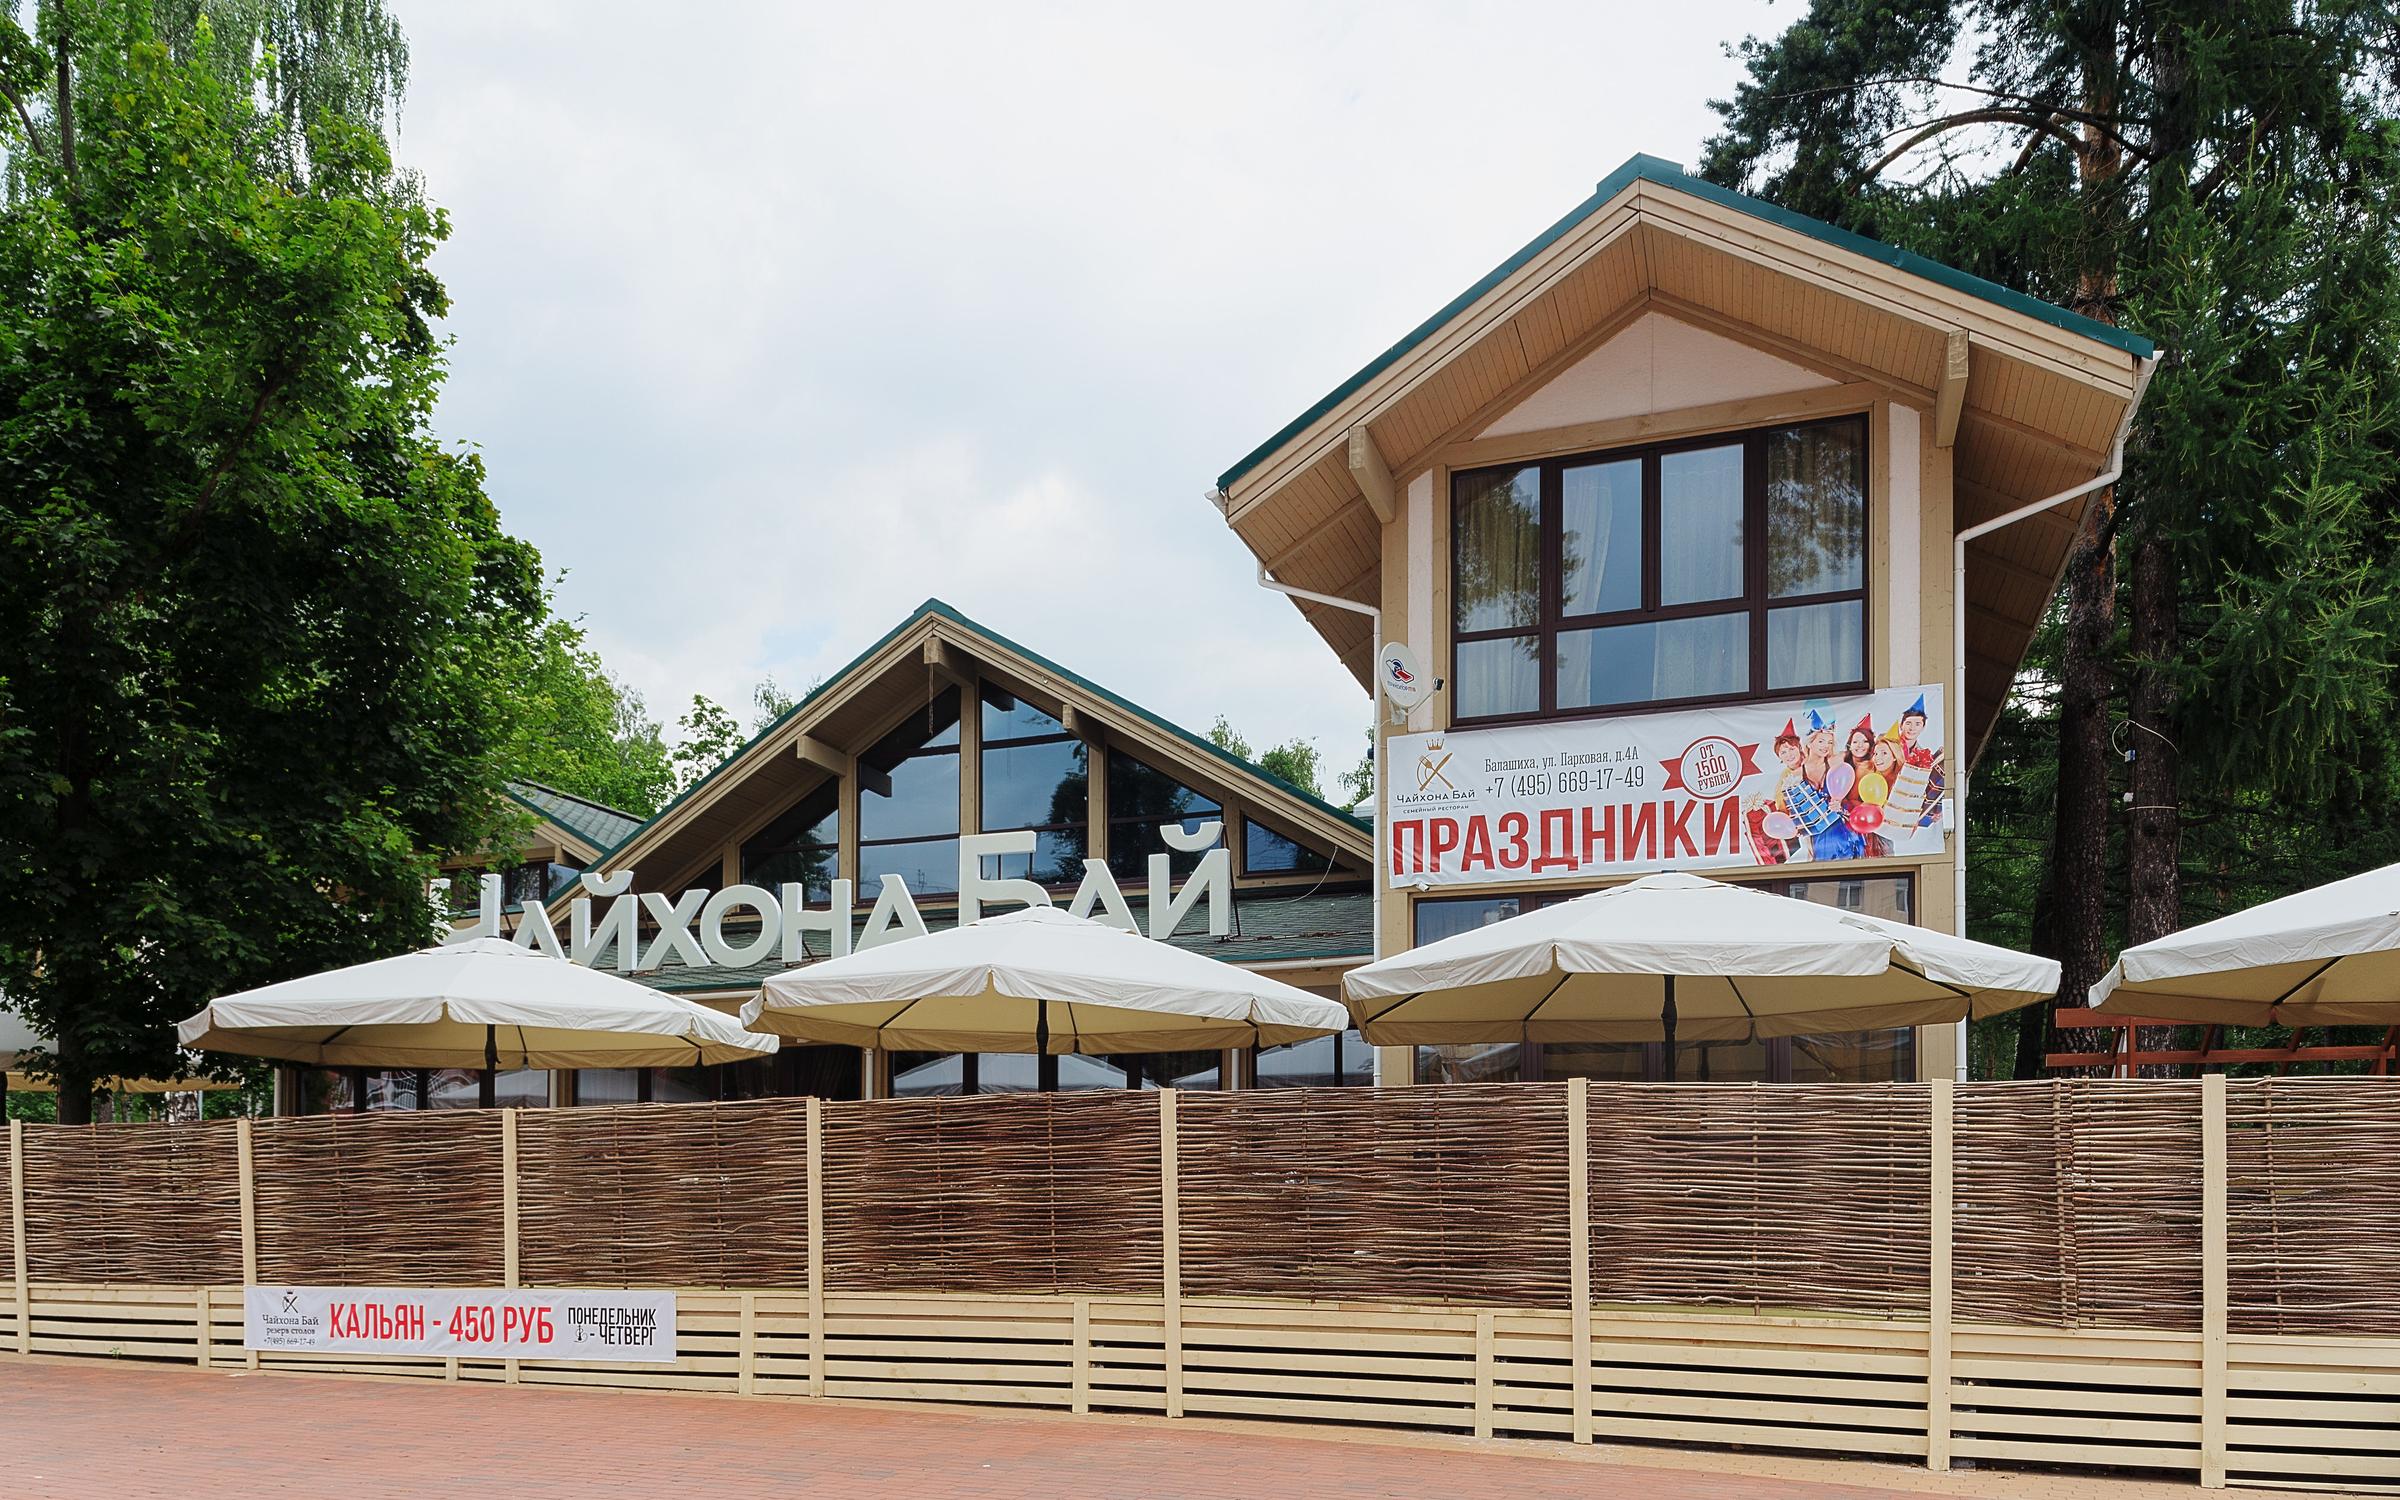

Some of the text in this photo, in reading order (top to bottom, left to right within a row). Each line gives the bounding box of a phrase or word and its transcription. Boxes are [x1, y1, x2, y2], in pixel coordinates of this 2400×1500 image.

[1485, 758, 1539, 773] Балашиха,
[1542, 755, 1557, 769] ул.
[1560, 750, 1612, 768] Парковая,
[1699, 744, 1714, 760] ОТ
[1695, 755, 1727, 779] 1500
[1485, 765, 1645, 798] +7 (495) 669-17-49
[1697, 770, 1732, 791] РУБЛЕЙ
[1392, 794, 1741, 876] ПРАЗДНИКИ
[262, 1314, 319, 1326] Чайхона Бай
[329, 1303, 424, 1341] КАЛЬЯН
[449, 1305, 495, 1343] 450
[503, 1306, 554, 1344] РУБ
[568, 1307, 656, 1326] ПОНЕДЕЛЬНИК
[266, 1327, 290, 1336] резерв
[599, 1324, 656, 1346] ЧЕТВЕРГ
